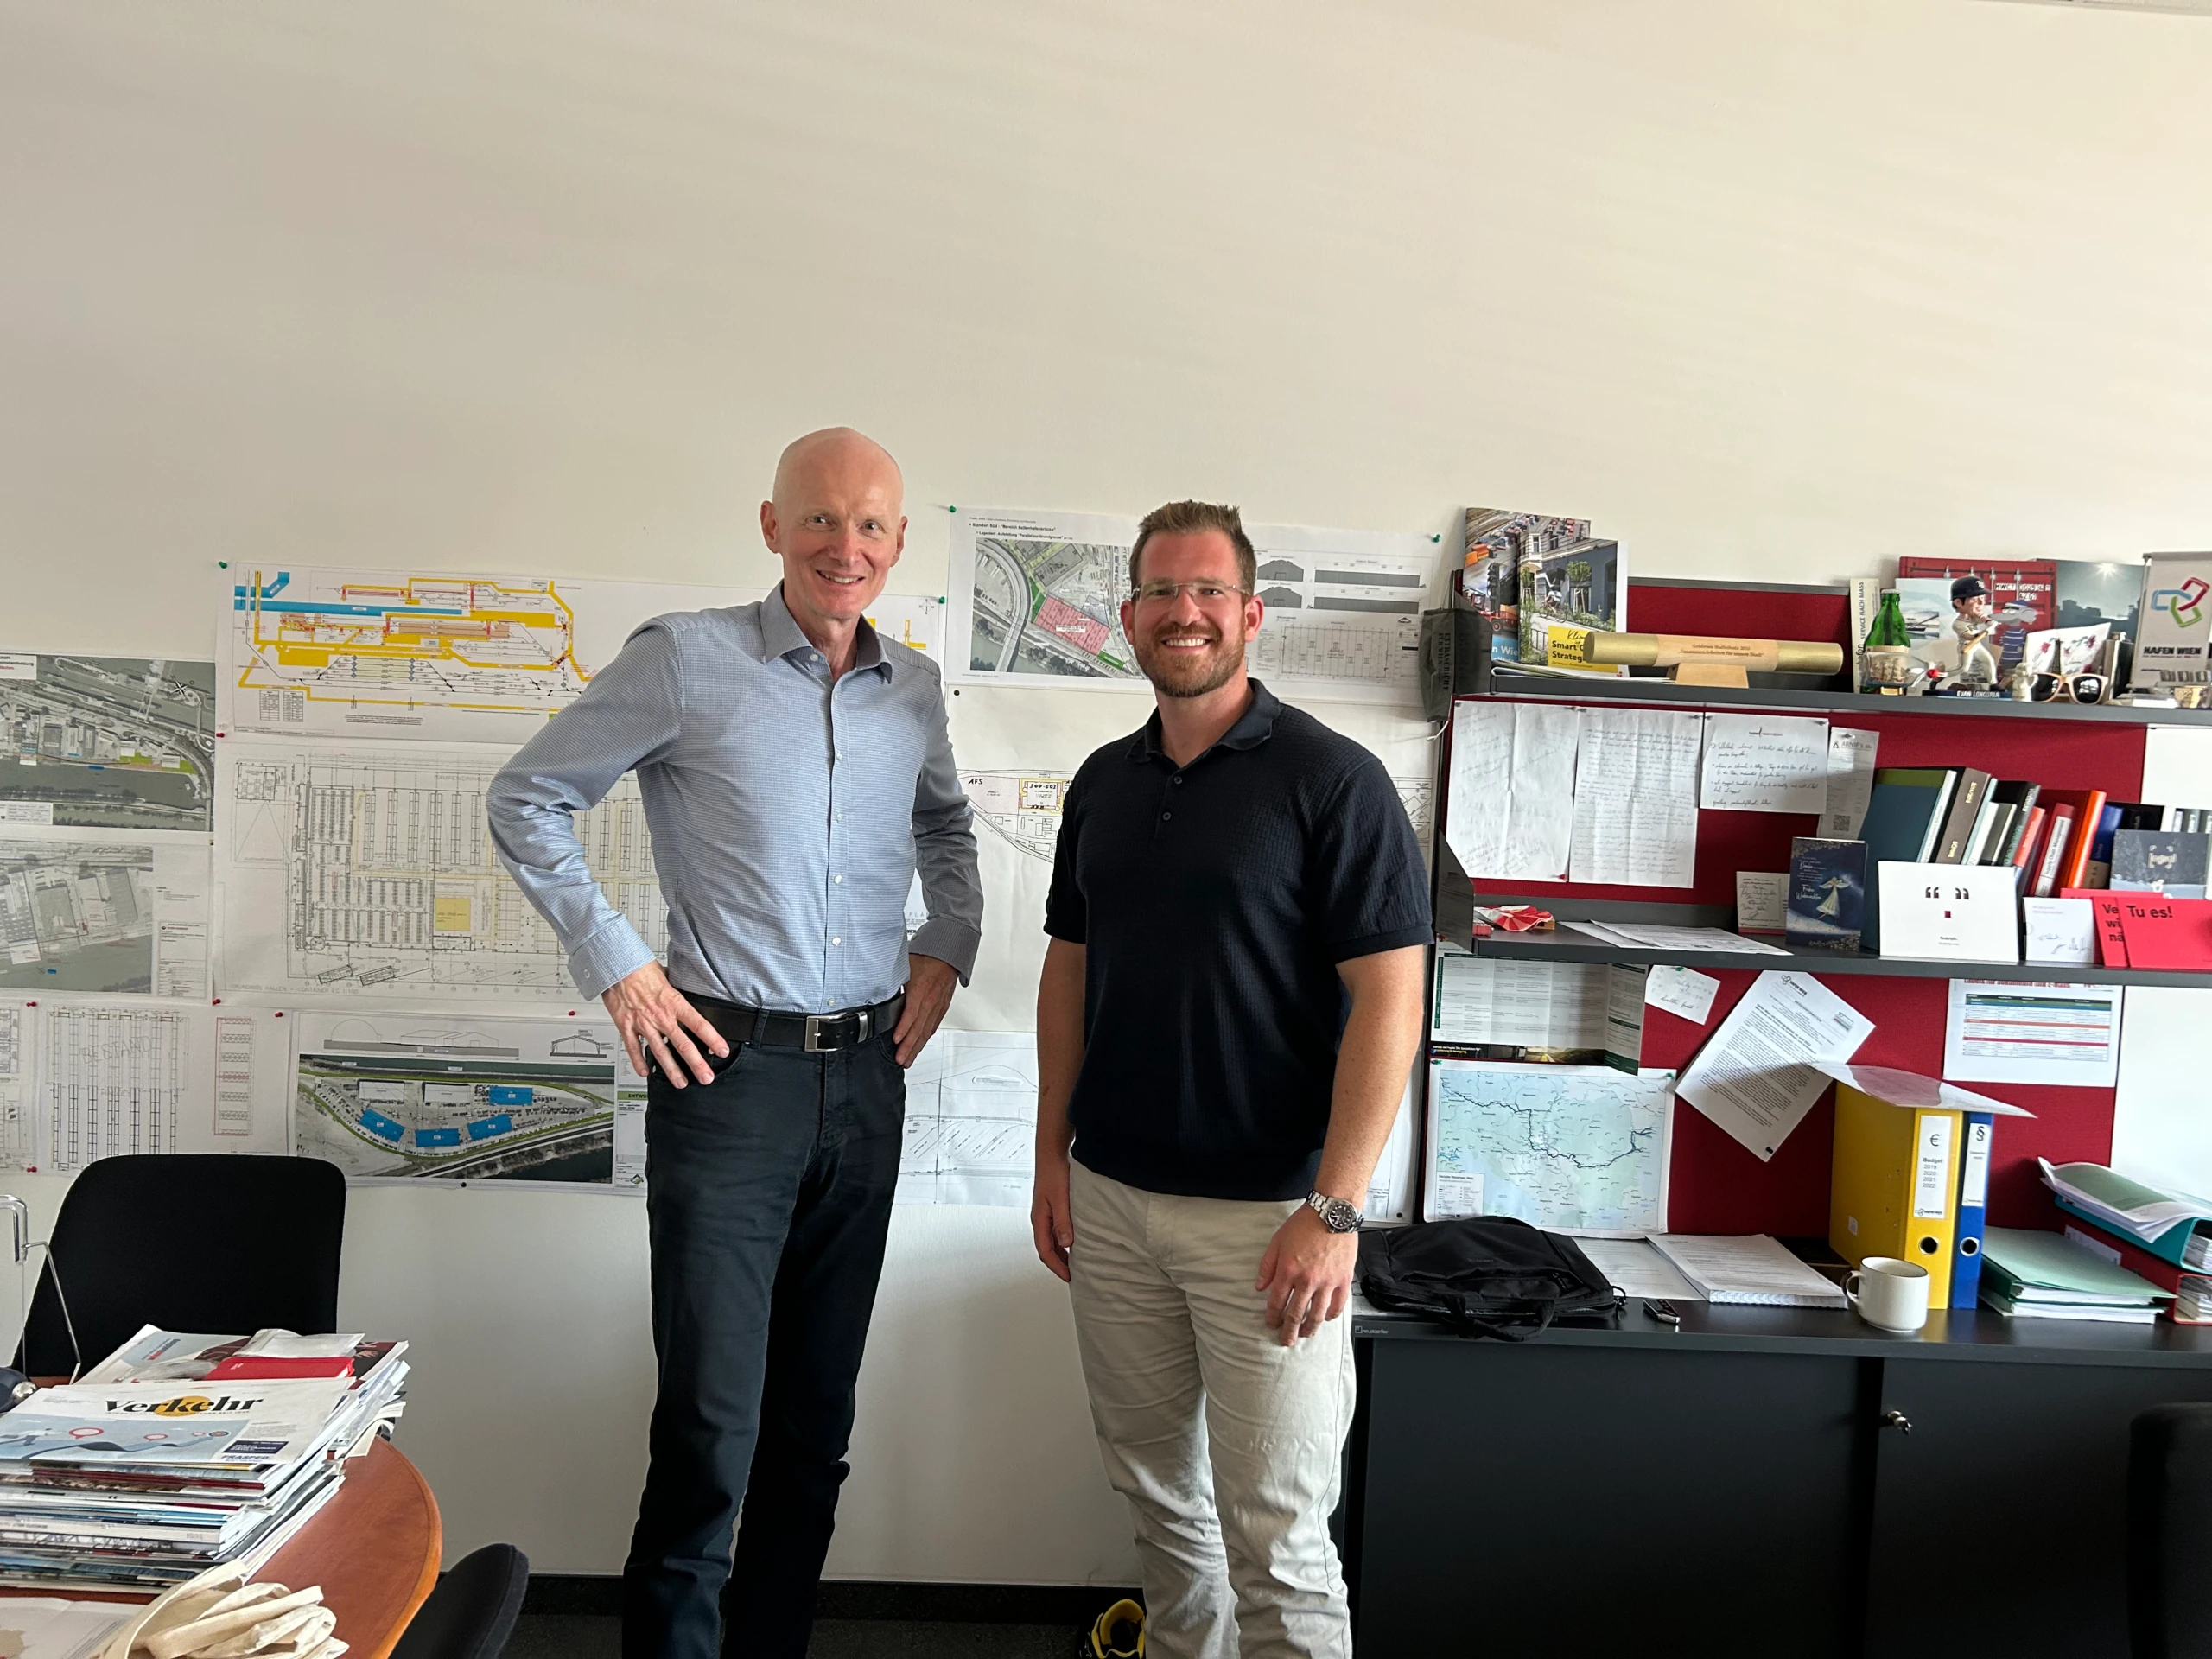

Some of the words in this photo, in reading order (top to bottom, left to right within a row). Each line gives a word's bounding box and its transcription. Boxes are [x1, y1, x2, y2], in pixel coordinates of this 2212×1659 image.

[1552, 640, 1577, 651] Smart
[2053, 819, 2065, 848] Management
[2048, 847, 2056, 860] Chain
[2044, 860, 2053, 875] Supply
[2101, 904, 2120, 914] Ve
[2126, 905, 2145, 918] Tu
[2150, 906, 2173, 918] es!
[81, 1036, 152, 1065] BESTAND
[1976, 1125, 1985, 1141] §
[1929, 1134, 1940, 1147] €
[105, 1395, 264, 1413] Verkehr
